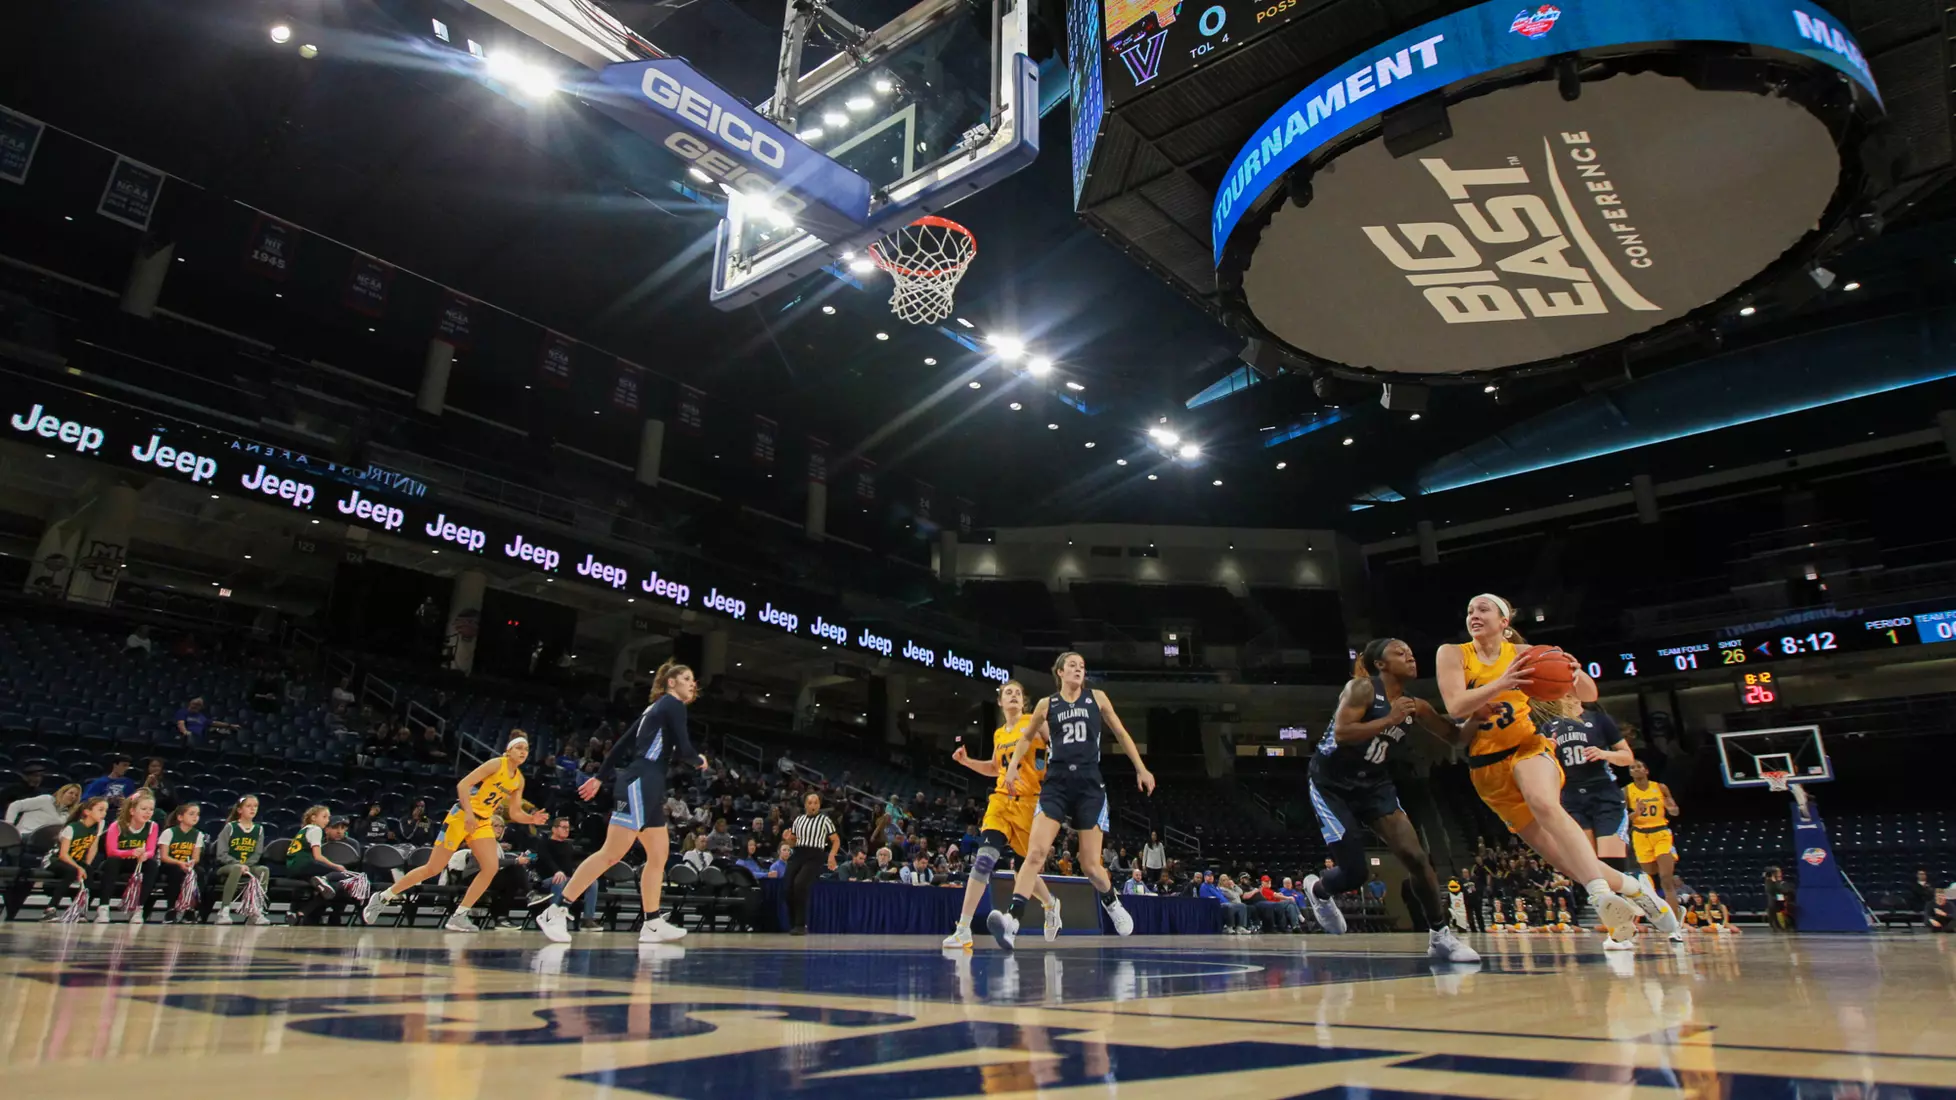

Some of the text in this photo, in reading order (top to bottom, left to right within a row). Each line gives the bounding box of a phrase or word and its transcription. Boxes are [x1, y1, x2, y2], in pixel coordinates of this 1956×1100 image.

[1199, 5, 1227, 37] 0
[1256, 0, 1297, 24] POSS
[1190, 33, 1230, 59] TOL 4
[641, 68, 785, 169] GEICO
[1216, 34, 1444, 232] TOURNAMENT
[116, 179, 149, 199] NCAA
[1561, 130, 1653, 269] CONFERENCE
[1419, 158, 1609, 317] EAST
[251, 249, 286, 270] 1945
[1361, 222, 1527, 324] BIG
[12, 404, 1010, 684] Jeep Jeep Jeep Jeep Jeep Jeep Jeep Jeep Jeep Jeep Jeep Jeep Jeep Jeep Jeep
[1865, 617, 1912, 631] PERIOD
[1917, 613, 1944, 623] TEAM
[1718, 639, 1743, 649] SHOT
[1780, 631, 1838, 655] 8:12
[1886, 629, 1899, 644] 1
[1620, 653, 1636, 661] TOL
[1657, 643, 1710, 657] TEAM FOULS
[1721, 648, 1746, 665] 26
[1624, 661, 1637, 677] 4
[1674, 655, 1698, 670] 01
[1744, 671, 1771, 685] 8:12
[1745, 684, 1775, 704] 26
[1057, 707, 1090, 724] VILLANOVA
[1062, 720, 1087, 745] 20
[1562, 745, 1588, 767] 30
[239, 851, 248, 865] 5
